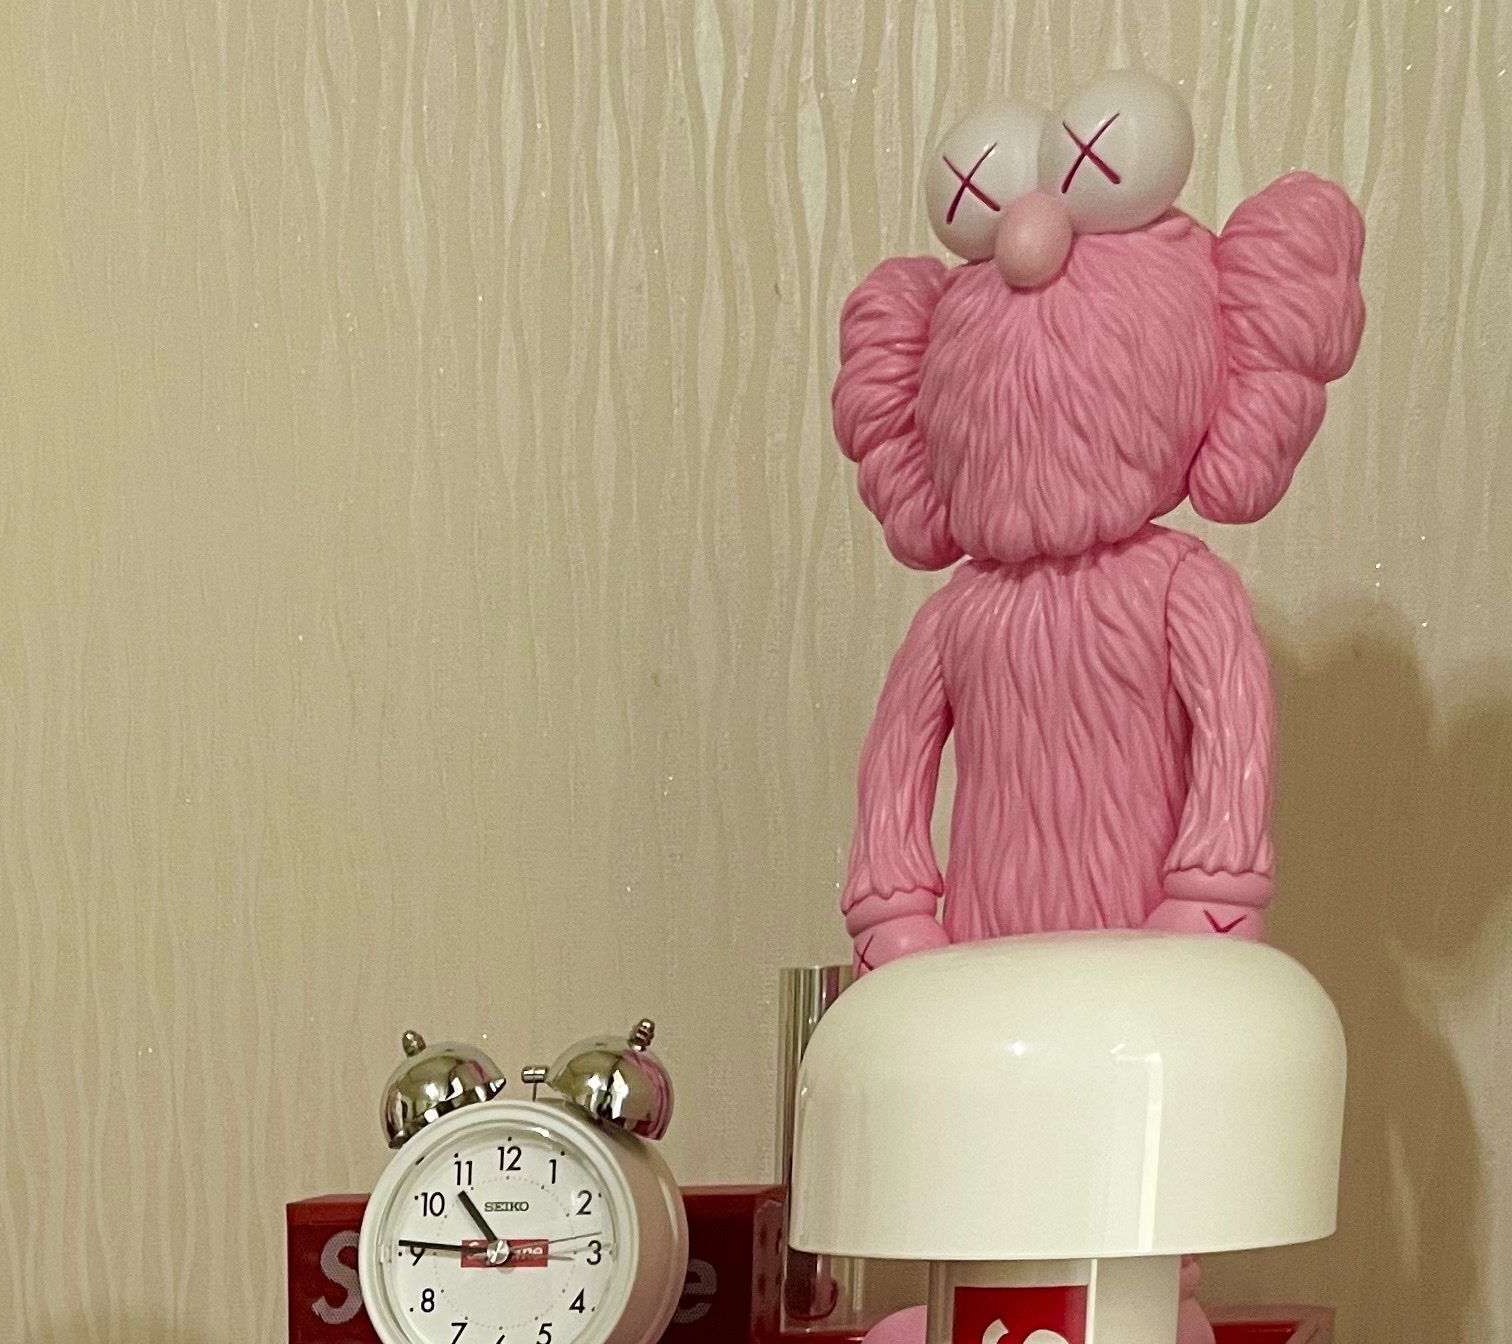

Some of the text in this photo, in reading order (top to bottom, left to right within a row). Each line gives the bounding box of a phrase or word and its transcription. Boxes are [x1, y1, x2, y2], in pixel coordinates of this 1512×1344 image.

[498, 1146, 522, 1171] 12
[454, 1160, 473, 1186] 11
[549, 1159, 557, 1184] 1
[420, 1192, 445, 1216] 10
[484, 1201, 529, 1212] SEIKO
[576, 1190, 592, 1215] 2
[409, 1243, 426, 1266] 9
[586, 1239, 601, 1265] 3
[420, 1288, 435, 1312] 8
[568, 1288, 586, 1313] 4
